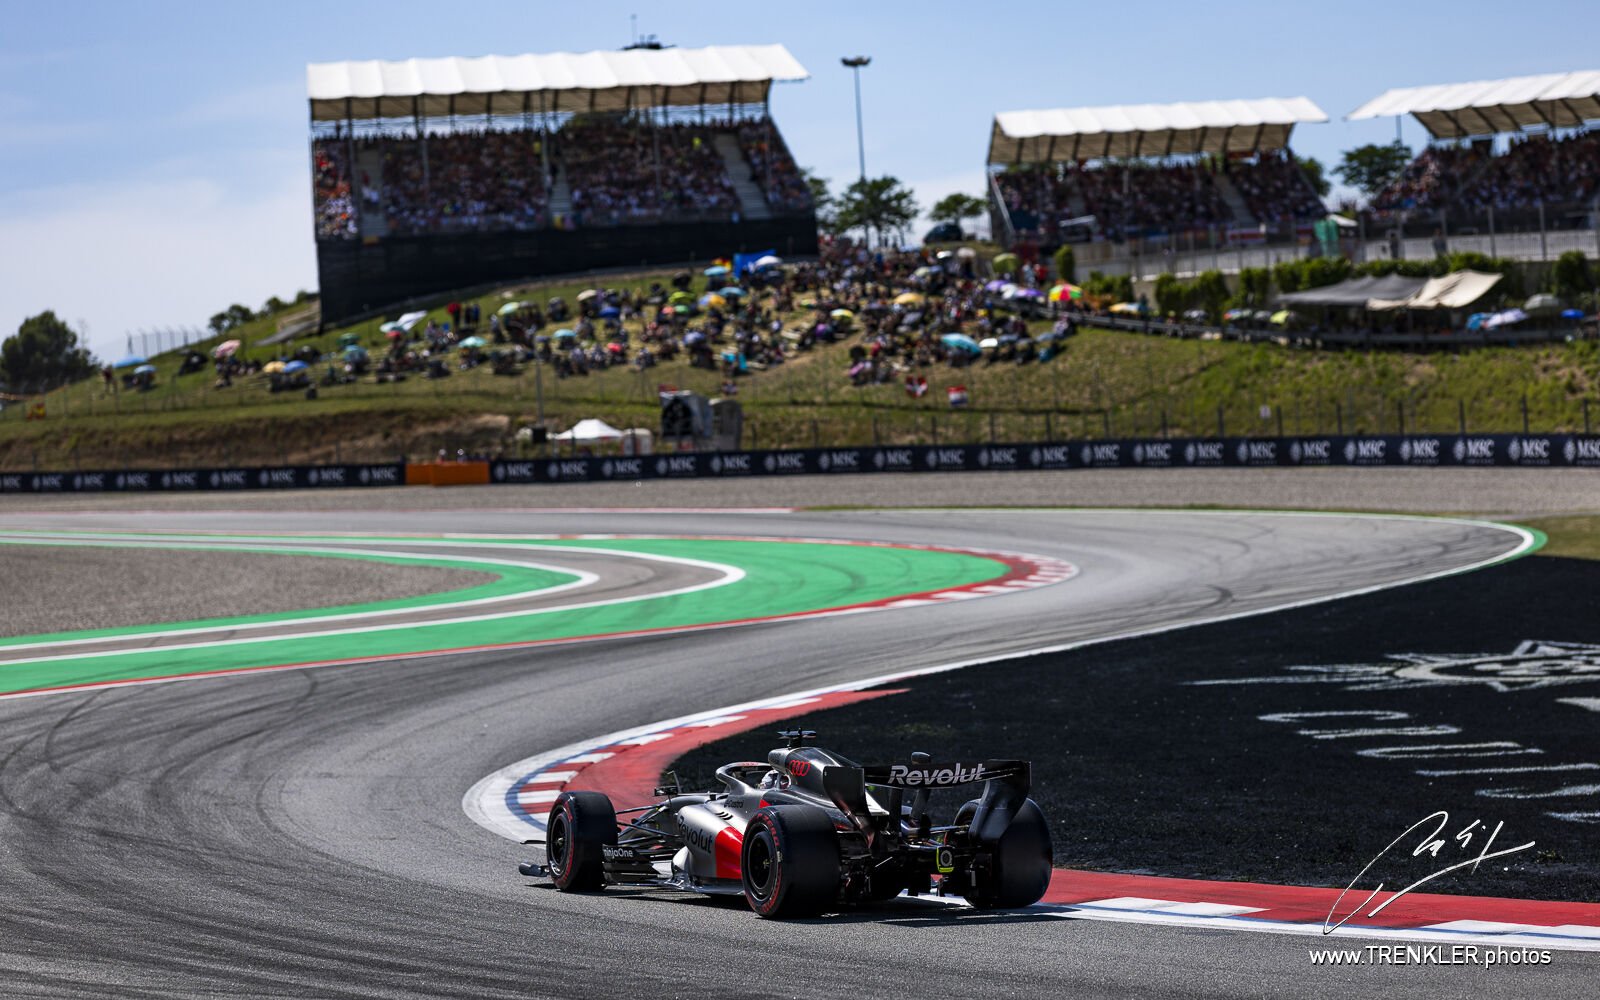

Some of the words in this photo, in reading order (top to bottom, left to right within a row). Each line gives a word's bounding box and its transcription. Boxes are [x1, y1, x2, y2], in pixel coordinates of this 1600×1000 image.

[1358, 440, 1385, 457] MSC
[1413, 440, 1439, 457] MSC
[1467, 439, 1494, 456] MSC
[1522, 439, 1549, 457] MSC
[888, 762, 986, 786] Revolut
